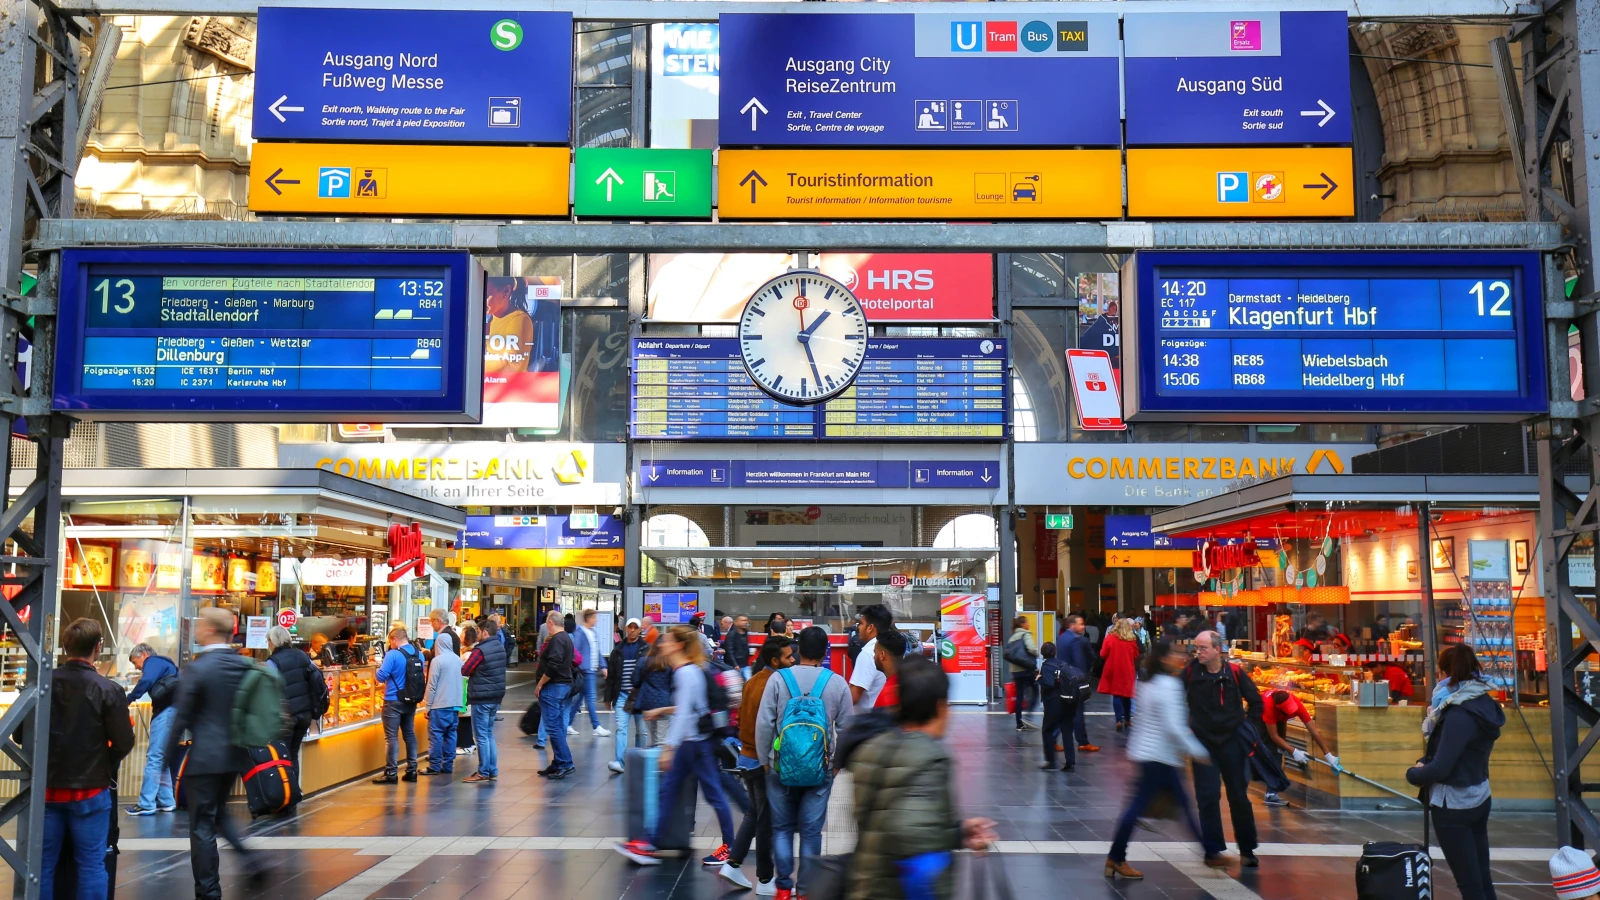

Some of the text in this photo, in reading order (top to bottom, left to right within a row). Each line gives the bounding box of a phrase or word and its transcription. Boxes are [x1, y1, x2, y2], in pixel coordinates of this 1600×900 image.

[495, 21, 517, 49] S
[956, 24, 977, 50] U
[988, 32, 1016, 41] Tram
[1027, 32, 1048, 41] Bus
[1060, 31, 1084, 41] TAXI
[322, 52, 438, 71] Ausgang Nord
[785, 56, 891, 75] Ausgang City
[322, 73, 444, 92] Fußweg Messe
[786, 79, 896, 94] ReiseZentrum
[1176, 76, 1283, 95] Ausgang Süd
[321, 105, 466, 117] Exit north, Walking route to the Fair
[809, 110, 832, 119] Travel
[833, 110, 862, 119] Center
[1243, 109, 1283, 117] Exit south
[321, 117, 466, 129] Sortie nord, Trajet à pied Exposition
[786, 123, 885, 134] Sortie, Centre de voyage
[1242, 121, 1283, 130] Sortie sud
[329, 174, 344, 196] P
[786, 172, 933, 187] Touristinformation
[1219, 173, 1240, 201] P
[786, 196, 952, 205] Tourist information Information tourisme
[976, 192, 1004, 201] Lounge
[182, 278, 228, 287] vorderen
[232, 278, 273, 289] Zugteile
[276, 279, 301, 288] nach
[305, 279, 374, 288] Stadtallendor
[867, 270, 934, 290] HRS
[399, 281, 444, 297] 13:52
[1161, 281, 1207, 297] 14:20
[93, 279, 136, 314] 13
[1228, 294, 1350, 306] Darmstadt Heidelberg
[1468, 281, 1511, 316] 12
[161, 297, 315, 310] Friedberg Gießen Marburg
[419, 299, 443, 309] RB41
[859, 297, 934, 311] Hotelportal
[1161, 298, 1196, 308] EC 117
[160, 308, 260, 322] Stadtallendorf
[1229, 306, 1377, 330] Klagenfurt Hbf
[157, 337, 312, 348] Friedberg Gießen Wetzlar
[417, 339, 441, 348] RB40
[485, 335, 520, 351] OR
[637, 341, 663, 349] Abfahrt
[1161, 339, 1207, 348] Folgezüge:
[157, 349, 225, 365] Dillenburg
[1162, 353, 1388, 368] 14:38 RE85 Wiebelsbach
[84, 366, 275, 376] Folgezüge: 15:02 ICE 1631 Berlin Hbf
[131, 378, 287, 387] 15:20 IC 2371 Karlsruhe Hbf
[484, 376, 507, 384] Alarm
[1162, 372, 1405, 390] 15:06 RB68 Heidelberg Hbf
[666, 468, 704, 476] Information
[1068, 457, 1297, 480] COMMERZBANK
[443, 485, 544, 498] an Ihrer Seite
[1124, 485, 1213, 497] Die Bank an
[827, 513, 848, 523] Beiß
[849, 513, 870, 523] mich
[872, 513, 891, 525] mal,
[892, 575, 976, 586] DB Information
[941, 641, 954, 658] S
